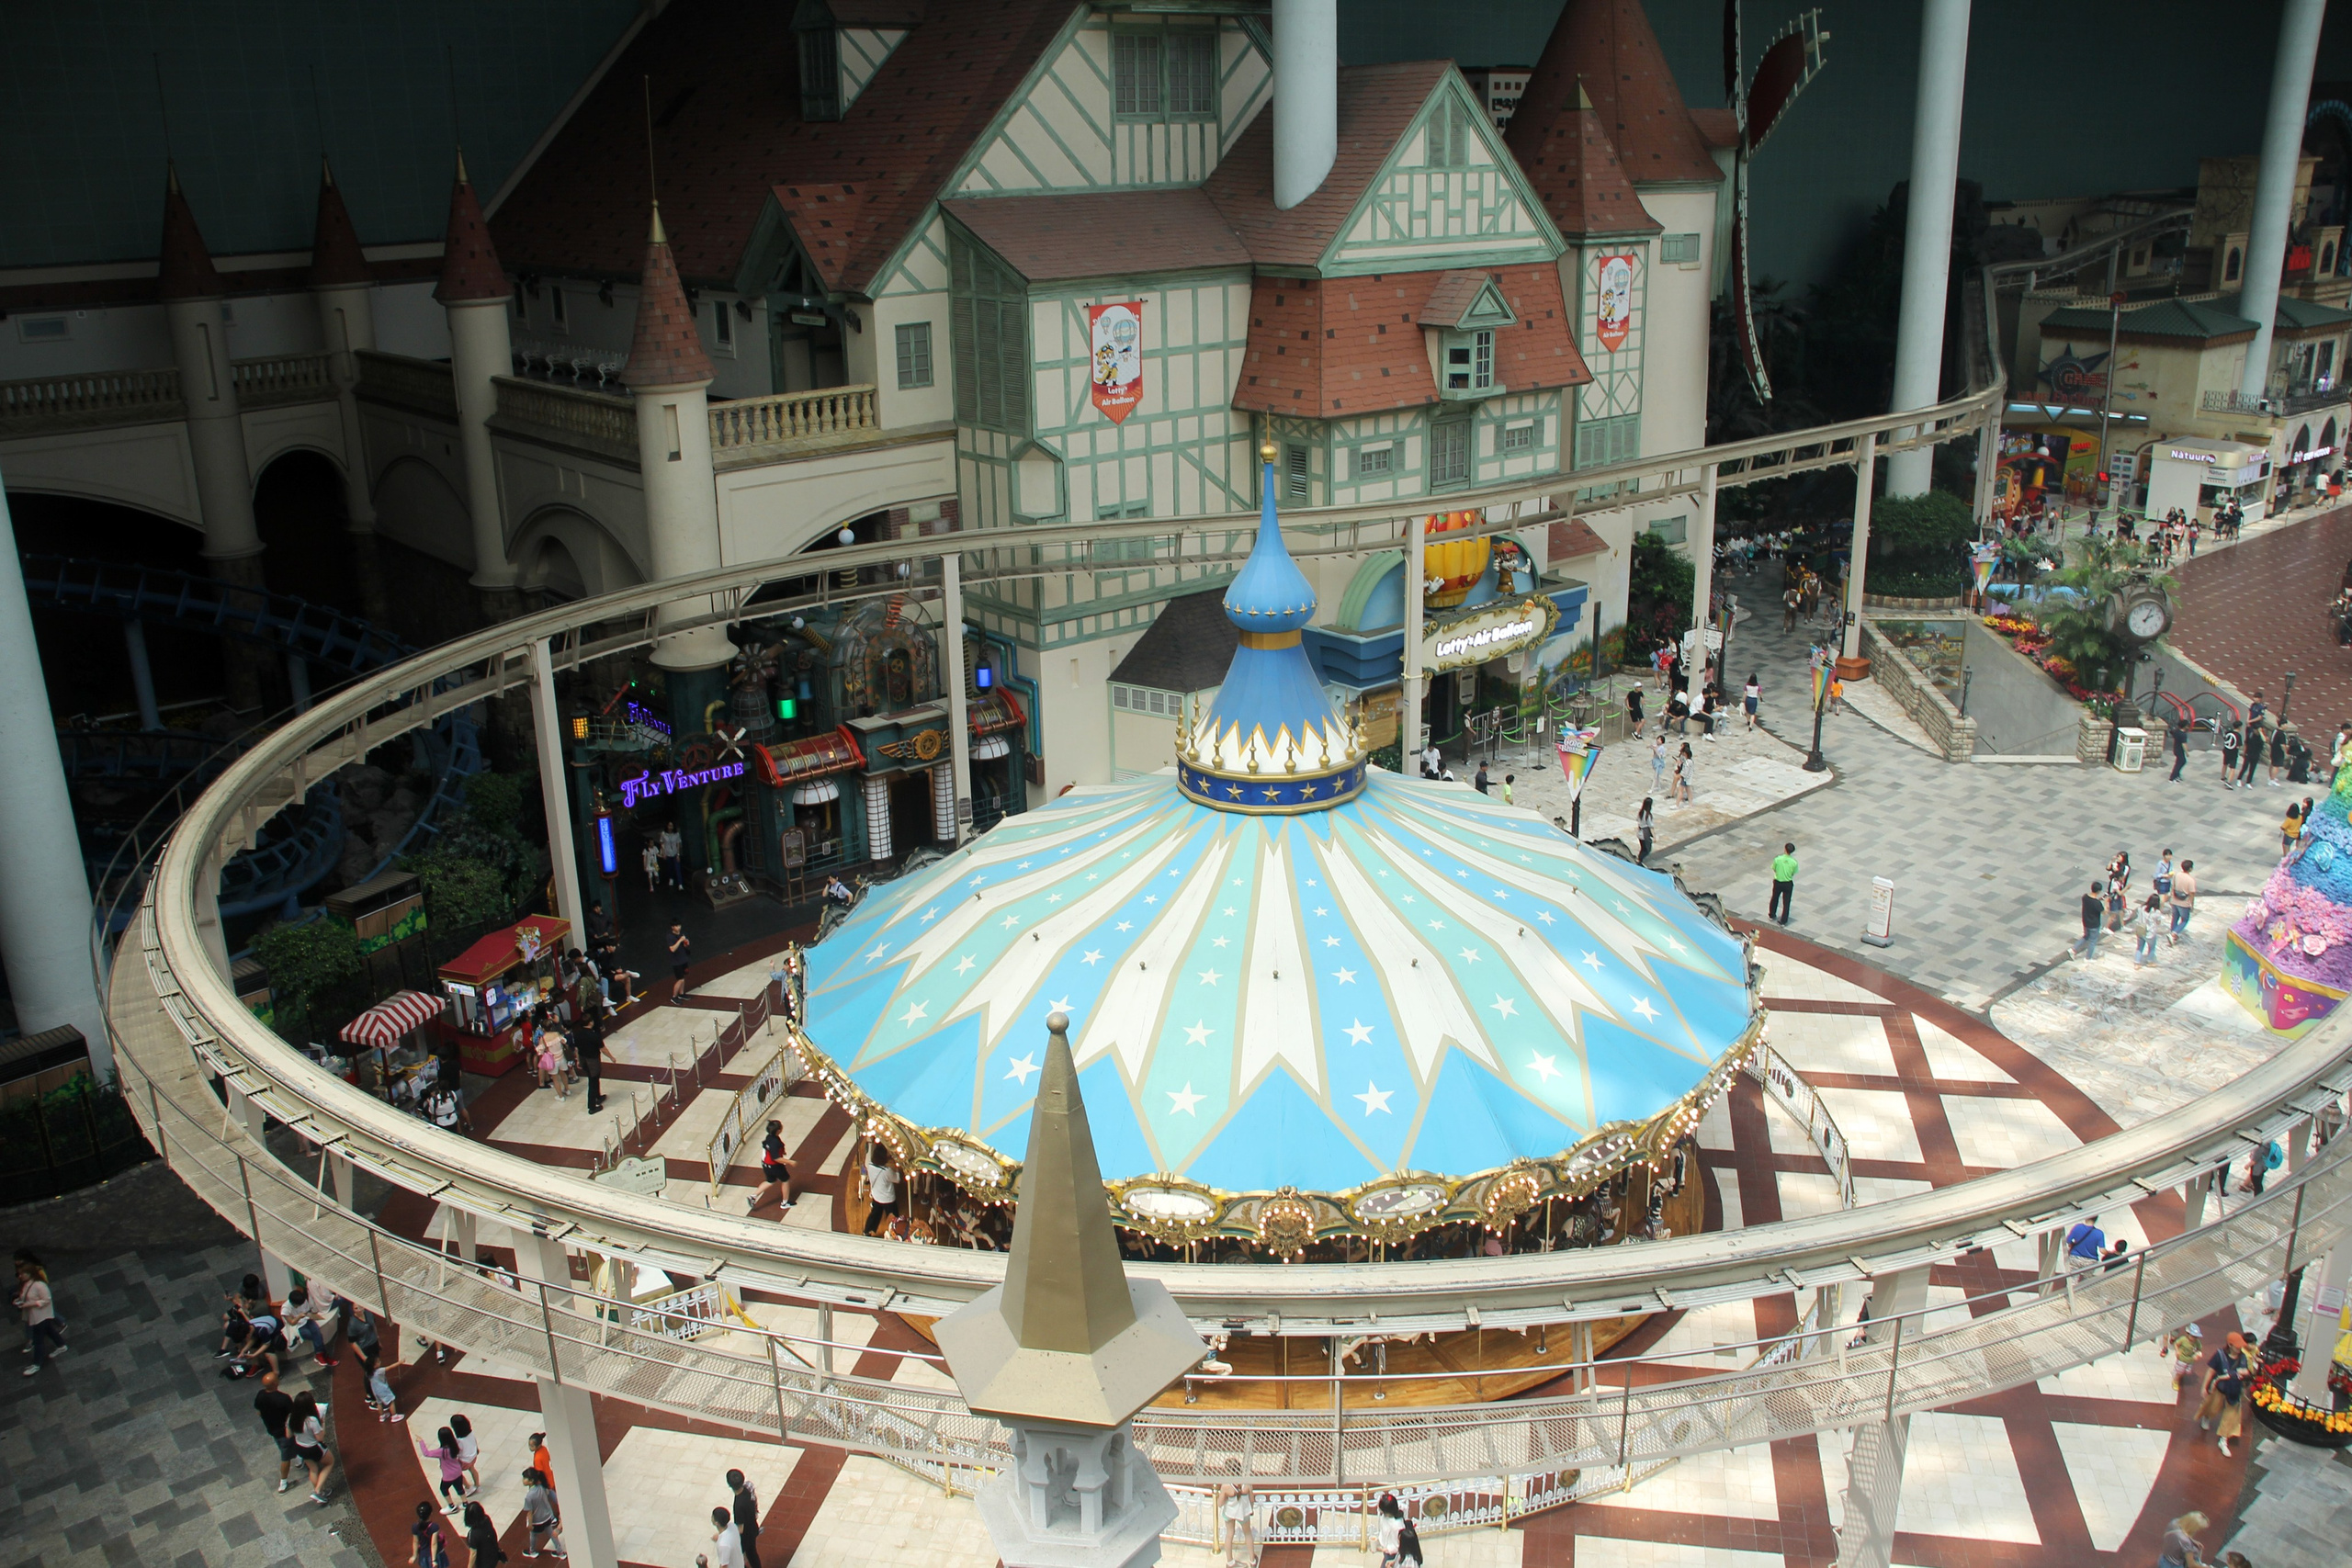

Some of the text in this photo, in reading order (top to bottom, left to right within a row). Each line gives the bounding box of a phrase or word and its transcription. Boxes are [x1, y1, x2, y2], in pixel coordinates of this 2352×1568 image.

[1102, 396, 1135, 406] Air Balloon
[1107, 386, 1128, 395] Lotty's
[1435, 619, 1533, 657] Lotty's Air Balloon
[660, 761, 744, 795] VENTURE
